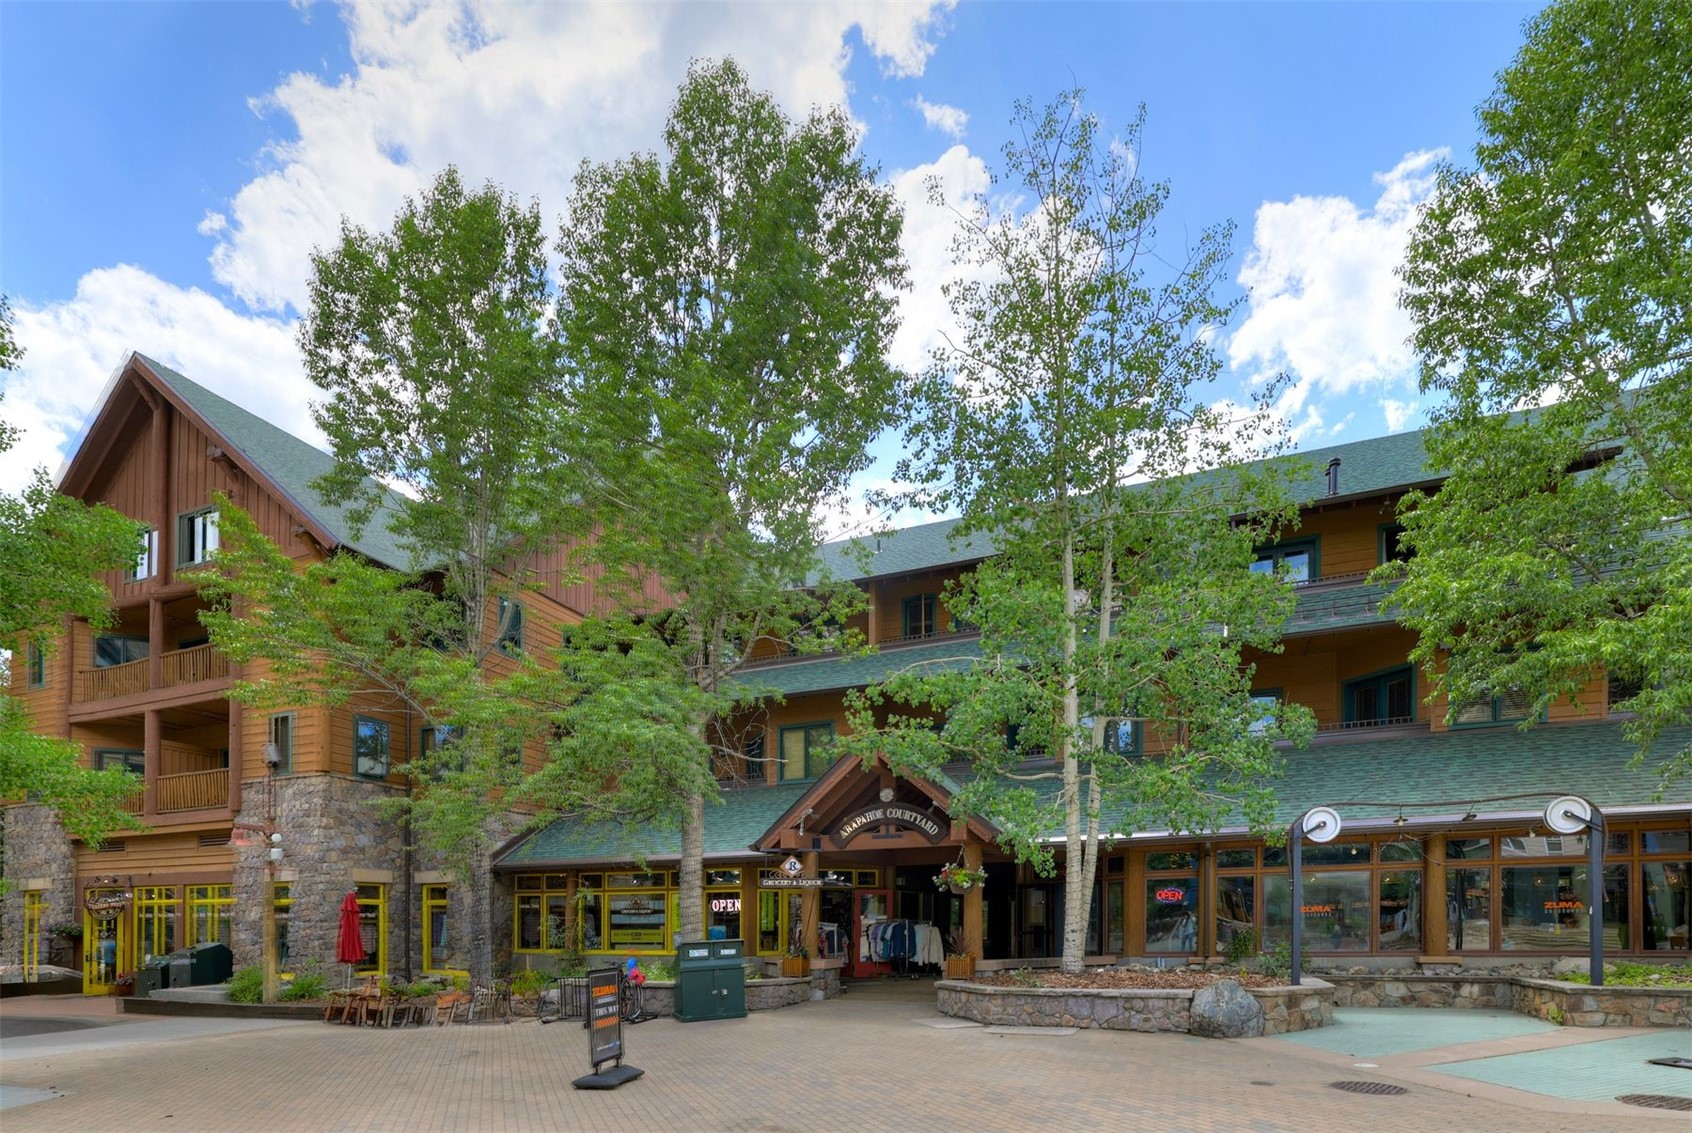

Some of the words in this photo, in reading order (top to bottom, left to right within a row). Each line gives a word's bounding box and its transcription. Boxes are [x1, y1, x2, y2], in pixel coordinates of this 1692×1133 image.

[839, 809, 884, 839] ARAPAHOE
[886, 808, 939, 836] COURTYARD
[1156, 890, 1183, 901] OPEN
[712, 899, 742, 912] OPEN
[1544, 901, 1585, 909] ZUMA
